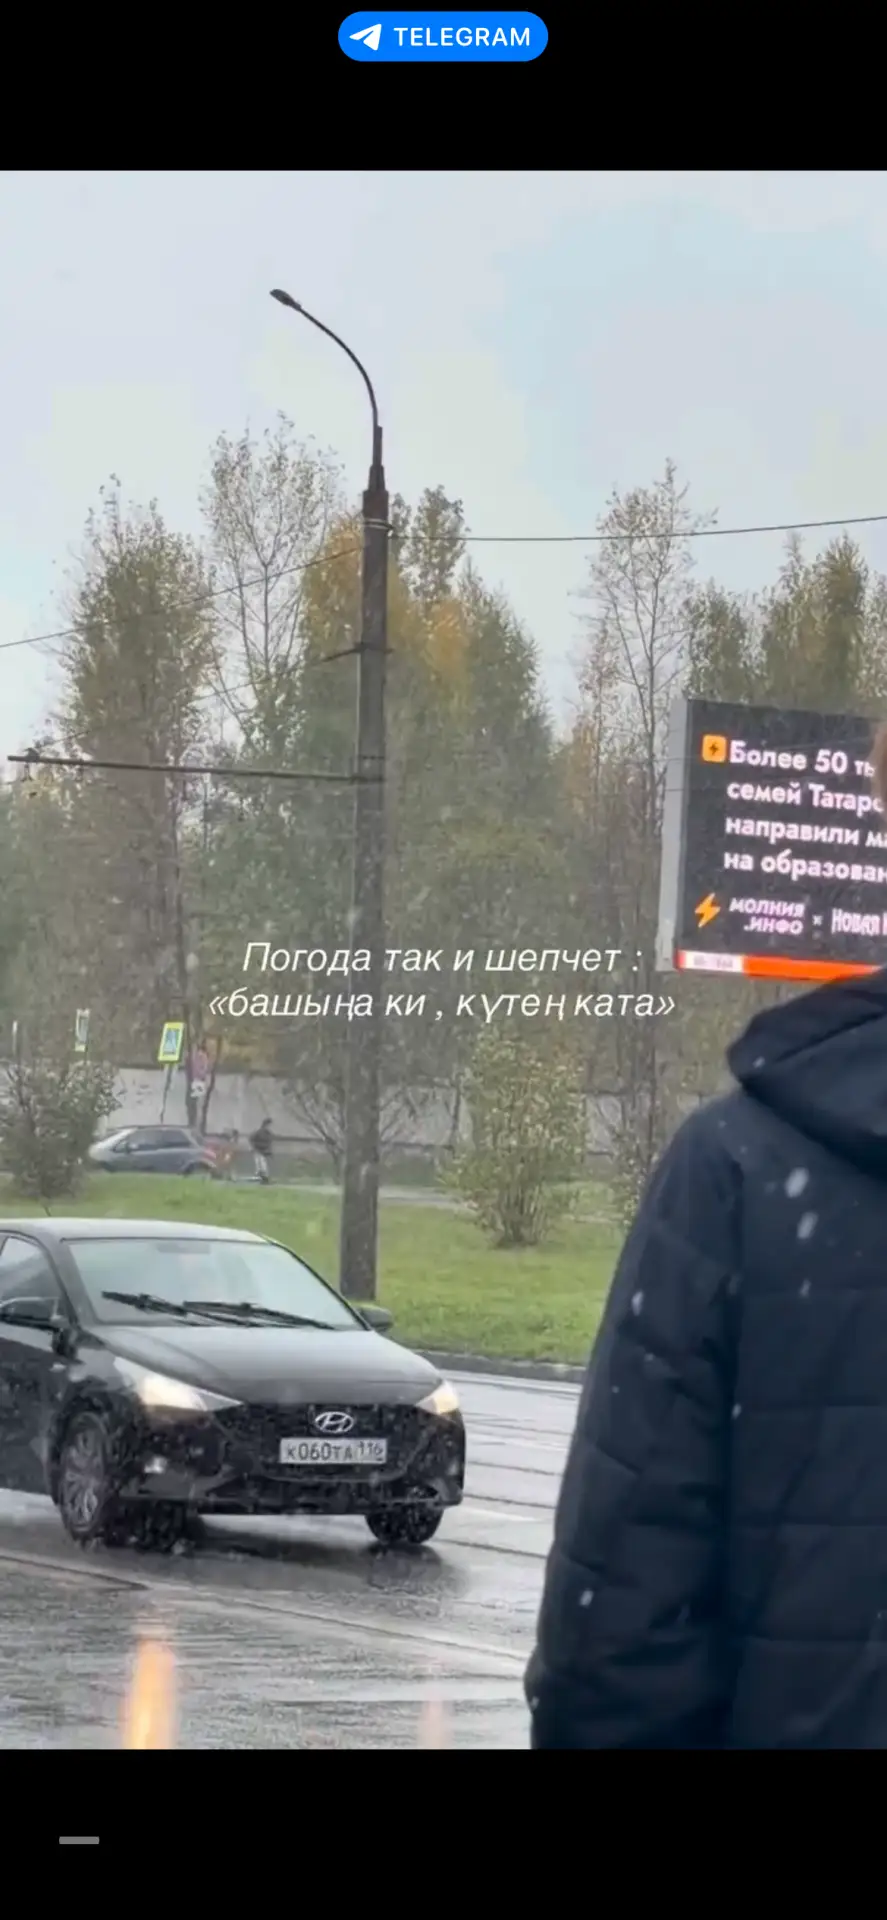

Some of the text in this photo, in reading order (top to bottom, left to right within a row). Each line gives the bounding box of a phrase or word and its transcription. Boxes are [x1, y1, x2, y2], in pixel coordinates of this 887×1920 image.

[729, 739, 808, 771] Более
[814, 748, 849, 775] 50
[726, 781, 802, 806] семей
[725, 816, 861, 847] направили
[723, 851, 755, 872] на
